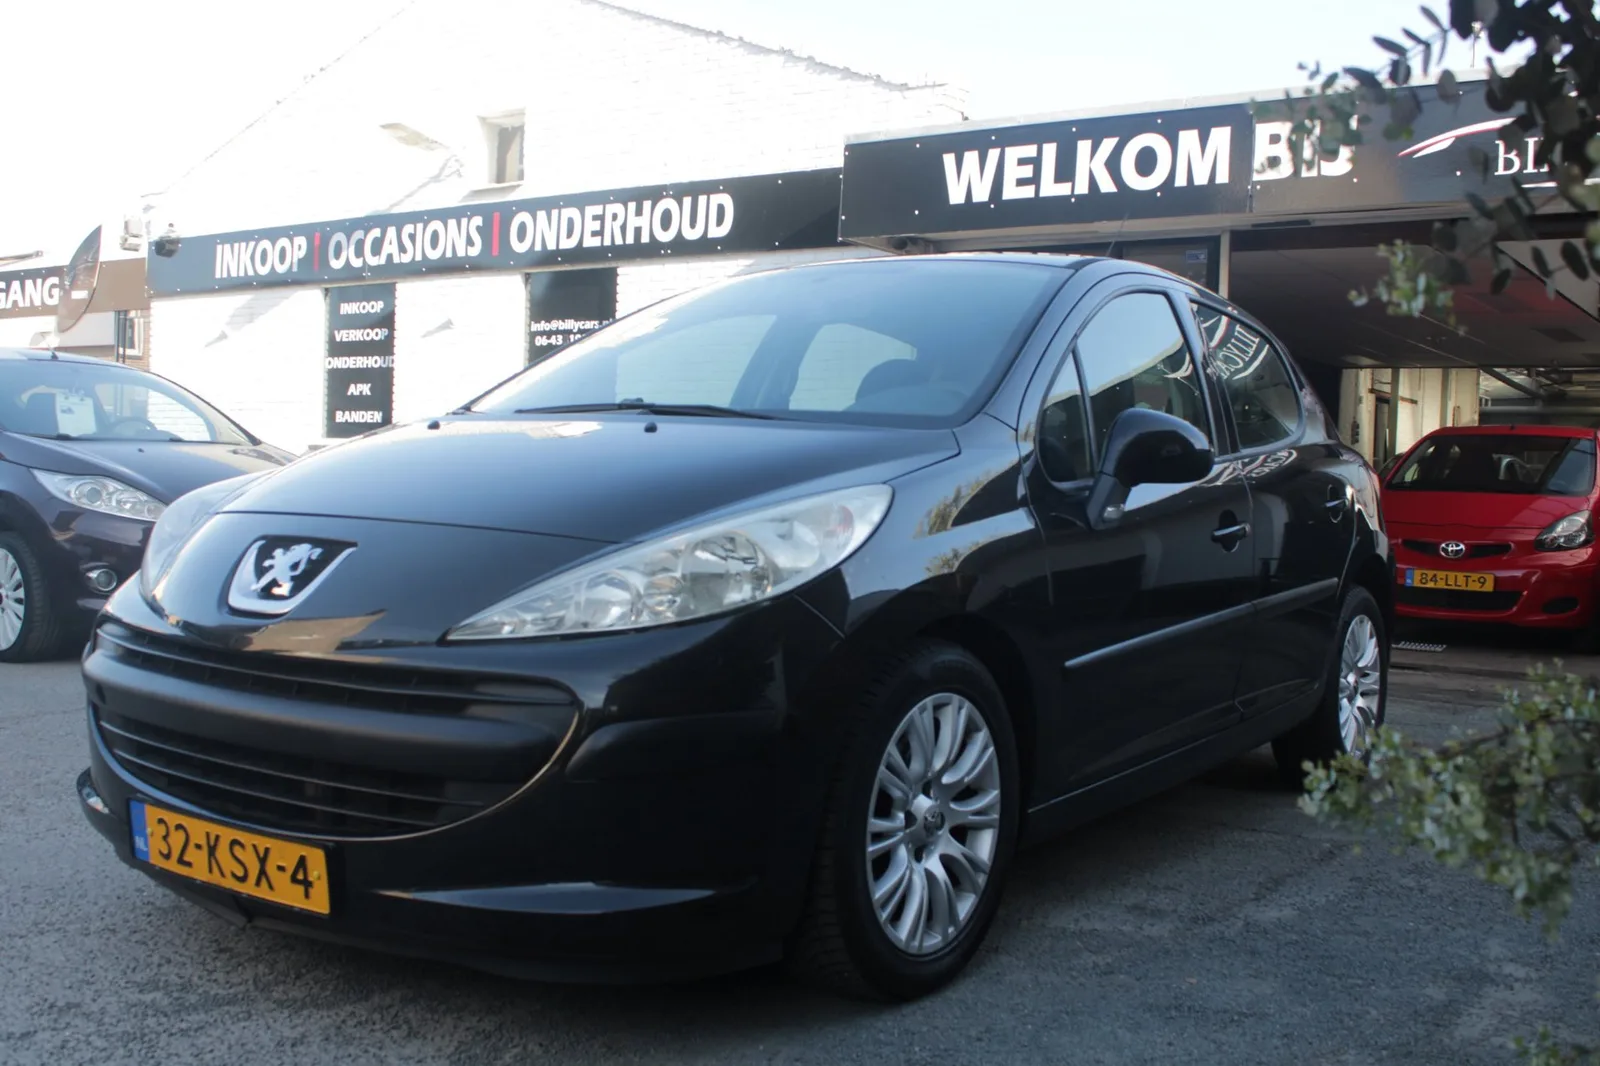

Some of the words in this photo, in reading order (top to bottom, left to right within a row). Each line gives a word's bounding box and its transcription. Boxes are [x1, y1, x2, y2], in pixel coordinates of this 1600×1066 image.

[943, 126, 1231, 205] WELKOM
[215, 236, 308, 278] INKOOP
[328, 215, 483, 270] OCCASIONS
[509, 193, 735, 254] ONDERHOUD
[340, 300, 384, 315] INKOOP
[334, 328, 388, 342] VERKOOP
[535, 334, 563, 347] 06-43
[347, 383, 372, 396] APK
[335, 411, 383, 423] BANDEN
[1419, 572, 1488, 589] 84-LLT-9
[156, 817, 314, 900] 32-KSX-4
